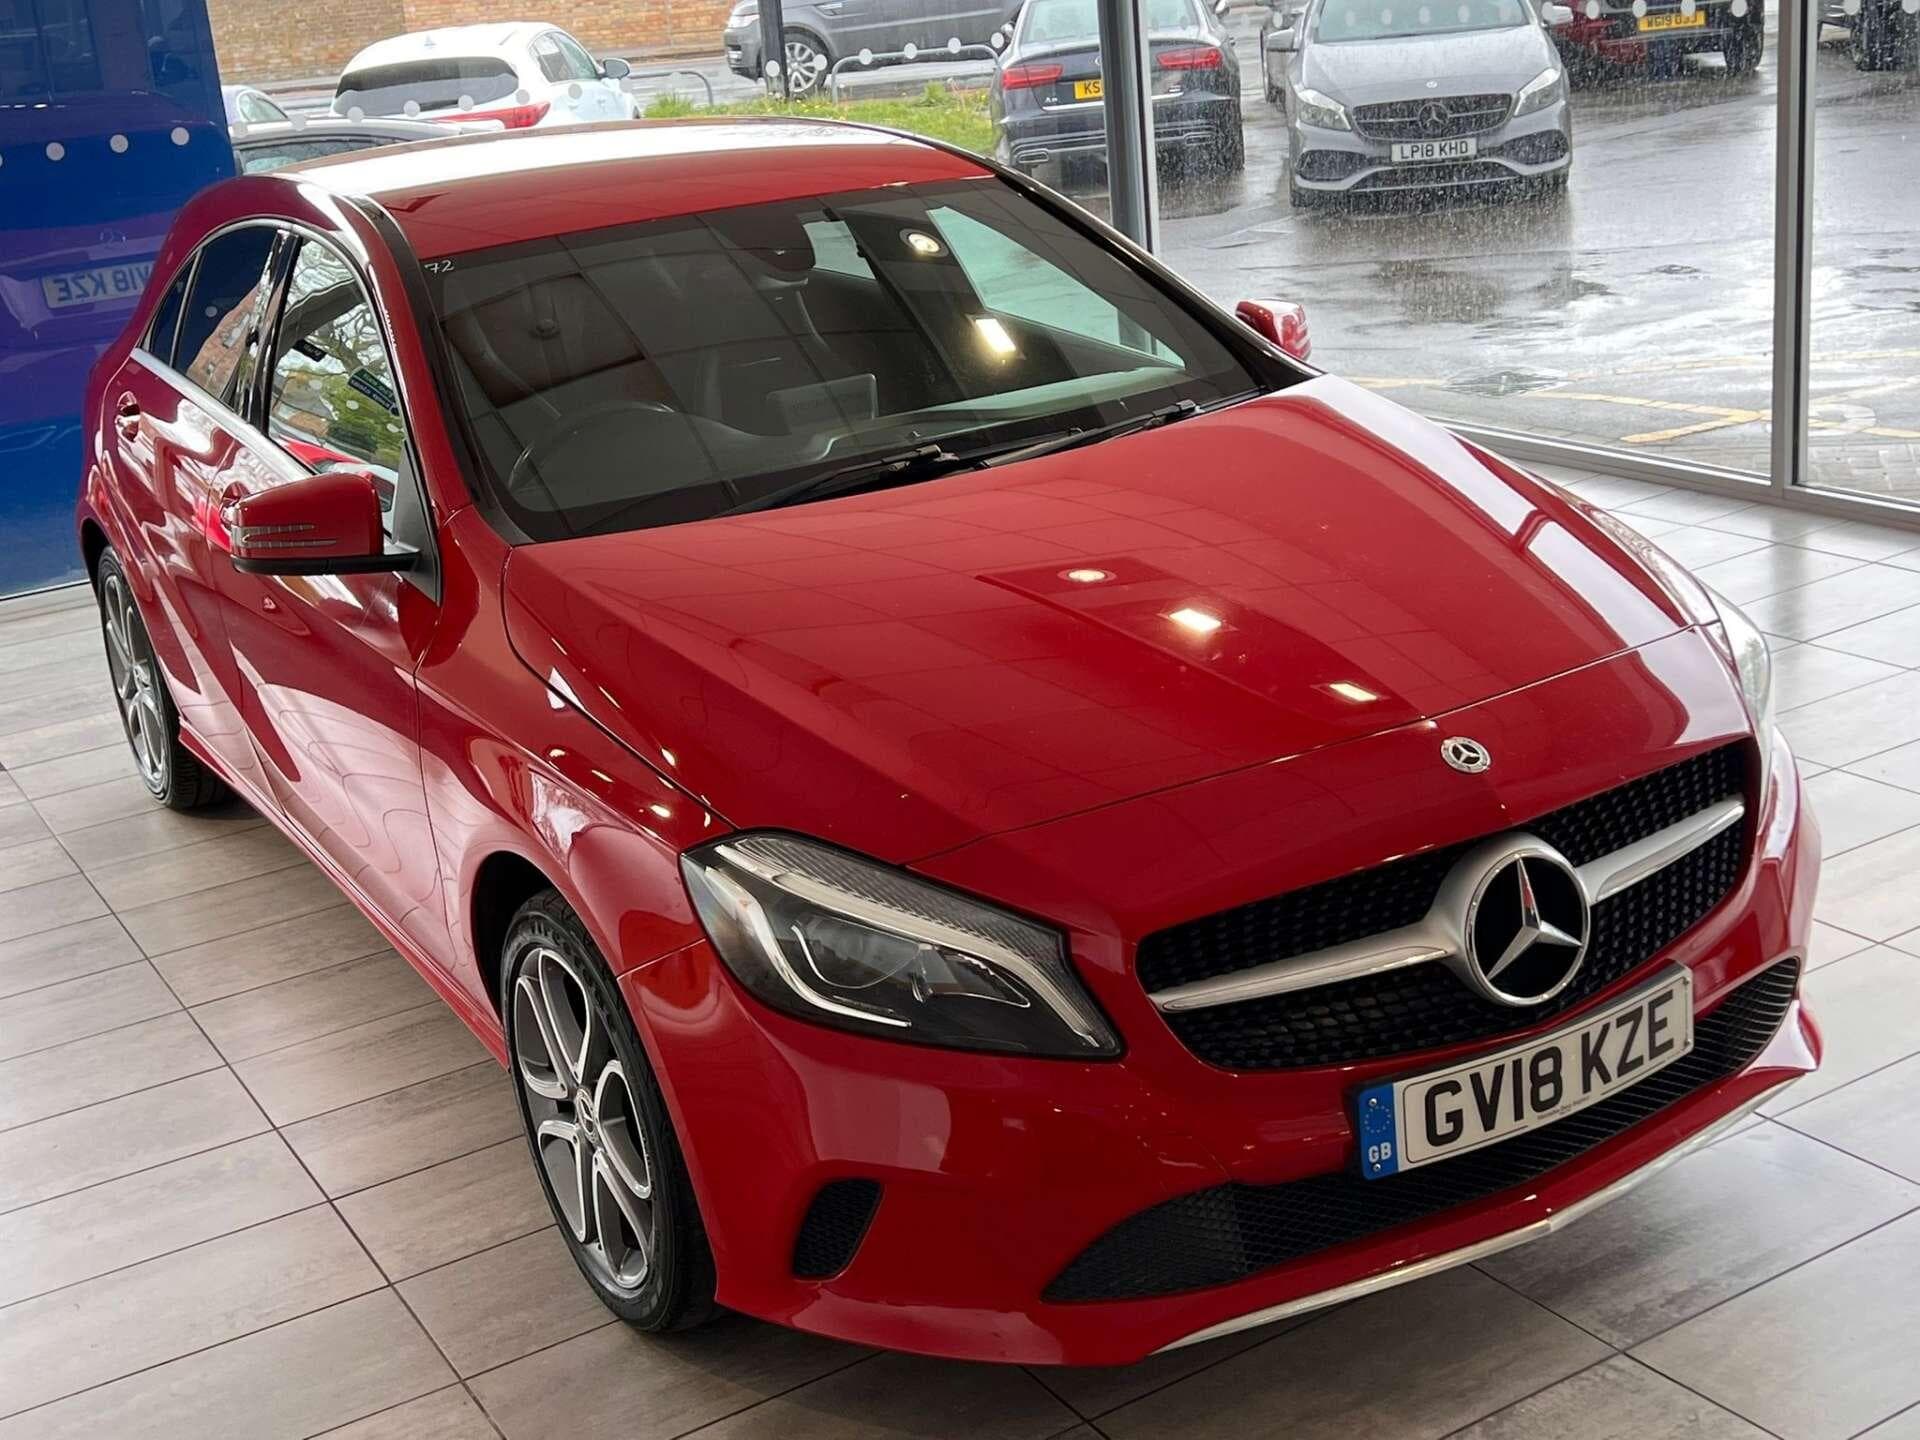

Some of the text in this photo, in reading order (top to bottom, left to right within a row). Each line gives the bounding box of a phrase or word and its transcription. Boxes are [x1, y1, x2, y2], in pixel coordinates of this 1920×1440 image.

[1084, 80, 1105, 95] KS
[1400, 140, 1469, 159] LP18 KHD
[424, 259, 455, 274] 72
[1424, 989, 1675, 1148] GV18 KZE
[1368, 1141, 1392, 1163] GB
